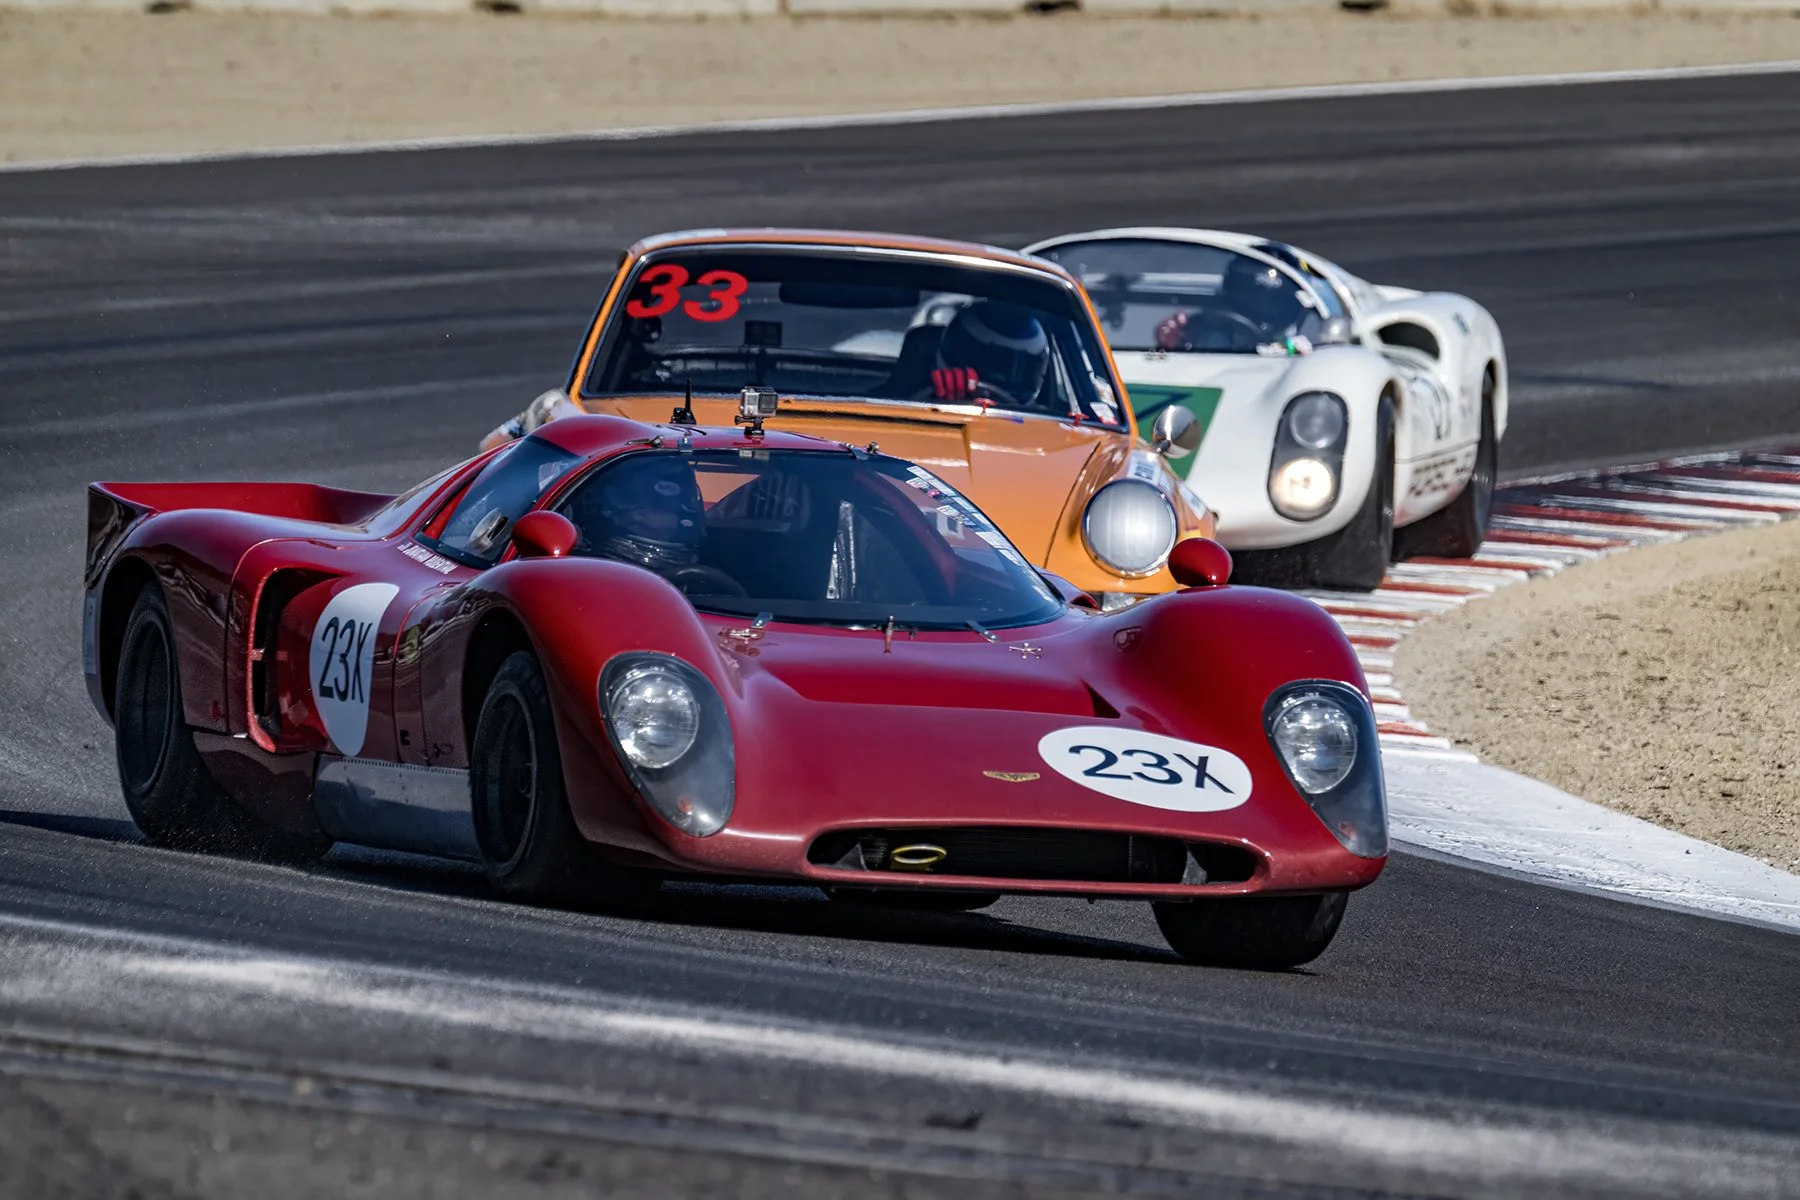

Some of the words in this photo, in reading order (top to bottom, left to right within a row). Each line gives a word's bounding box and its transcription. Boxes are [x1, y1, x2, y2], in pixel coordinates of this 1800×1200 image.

[626, 264, 748, 322] 33
[319, 616, 373, 703] 23X
[1068, 745, 1235, 794] 23X
